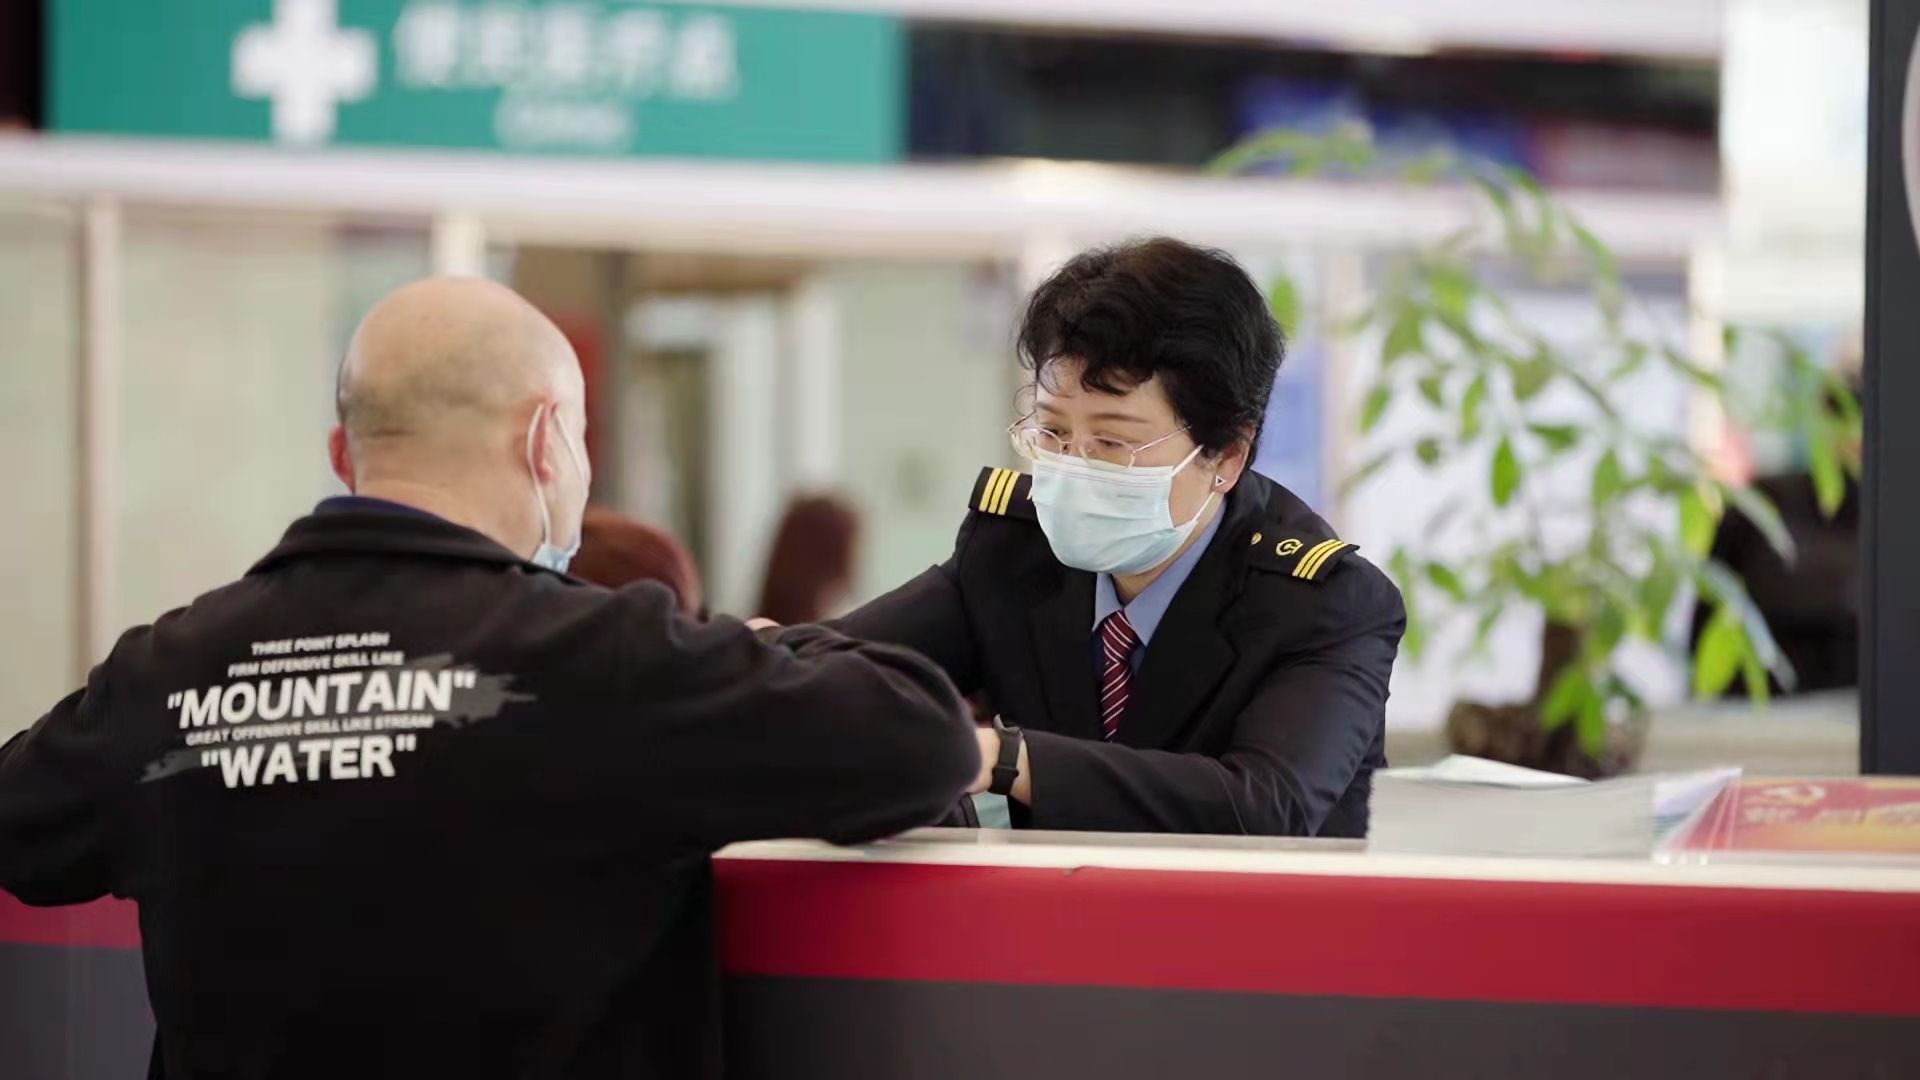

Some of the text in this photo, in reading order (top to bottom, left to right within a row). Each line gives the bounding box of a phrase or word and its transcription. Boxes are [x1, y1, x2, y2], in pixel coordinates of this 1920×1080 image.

[252, 632, 390, 655] THREE POINT SPLASH
[228, 651, 404, 677] FIRM DEFENSIVE SKILL LIKE
[167, 670, 476, 729] "MOUNTAIN"
[186, 714, 434, 746] GREAT OFFENSIVE SKILL LIKE STREAM
[201, 735, 417, 789] "WATER"
